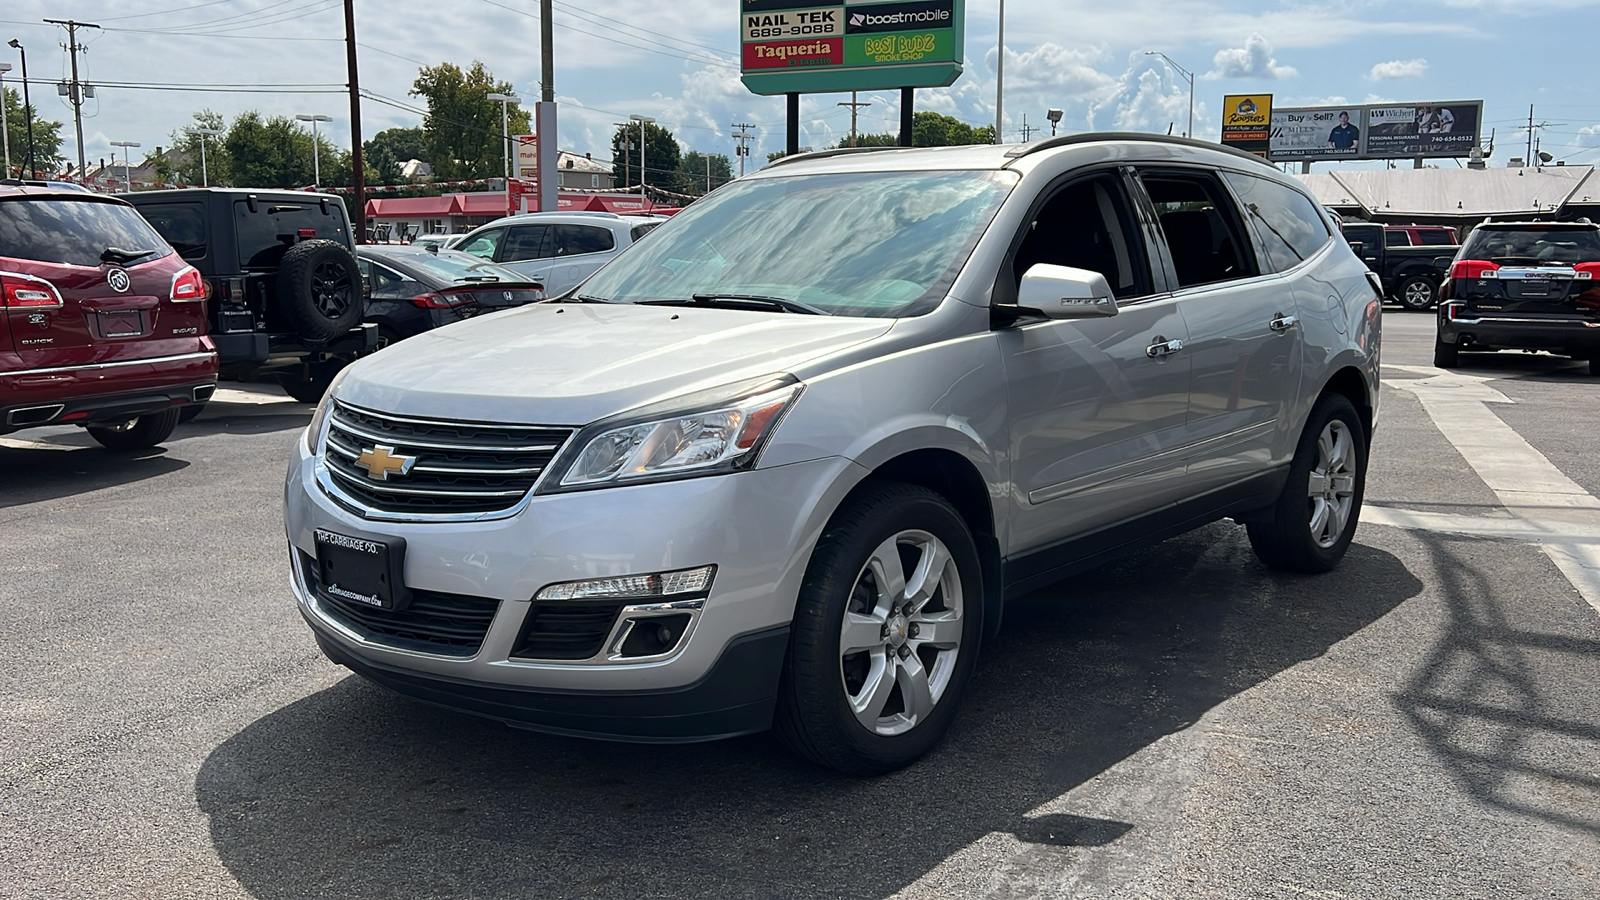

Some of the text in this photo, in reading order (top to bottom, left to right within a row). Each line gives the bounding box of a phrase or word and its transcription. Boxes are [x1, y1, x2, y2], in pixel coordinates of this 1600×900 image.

[748, 11, 835, 27] NAIL TEK
[866, 9, 949, 25] boostmobile
[750, 24, 834, 37] 689-9088
[875, 52, 923, 62] SMOKE SHOP
[1228, 113, 1265, 124] Roosters
[1288, 114, 1305, 123] Buy
[1313, 113, 1334, 121] Sell?
[1385, 109, 1414, 117] Wichert
[316, 530, 378, 554] THE CARRIAGE CO.
